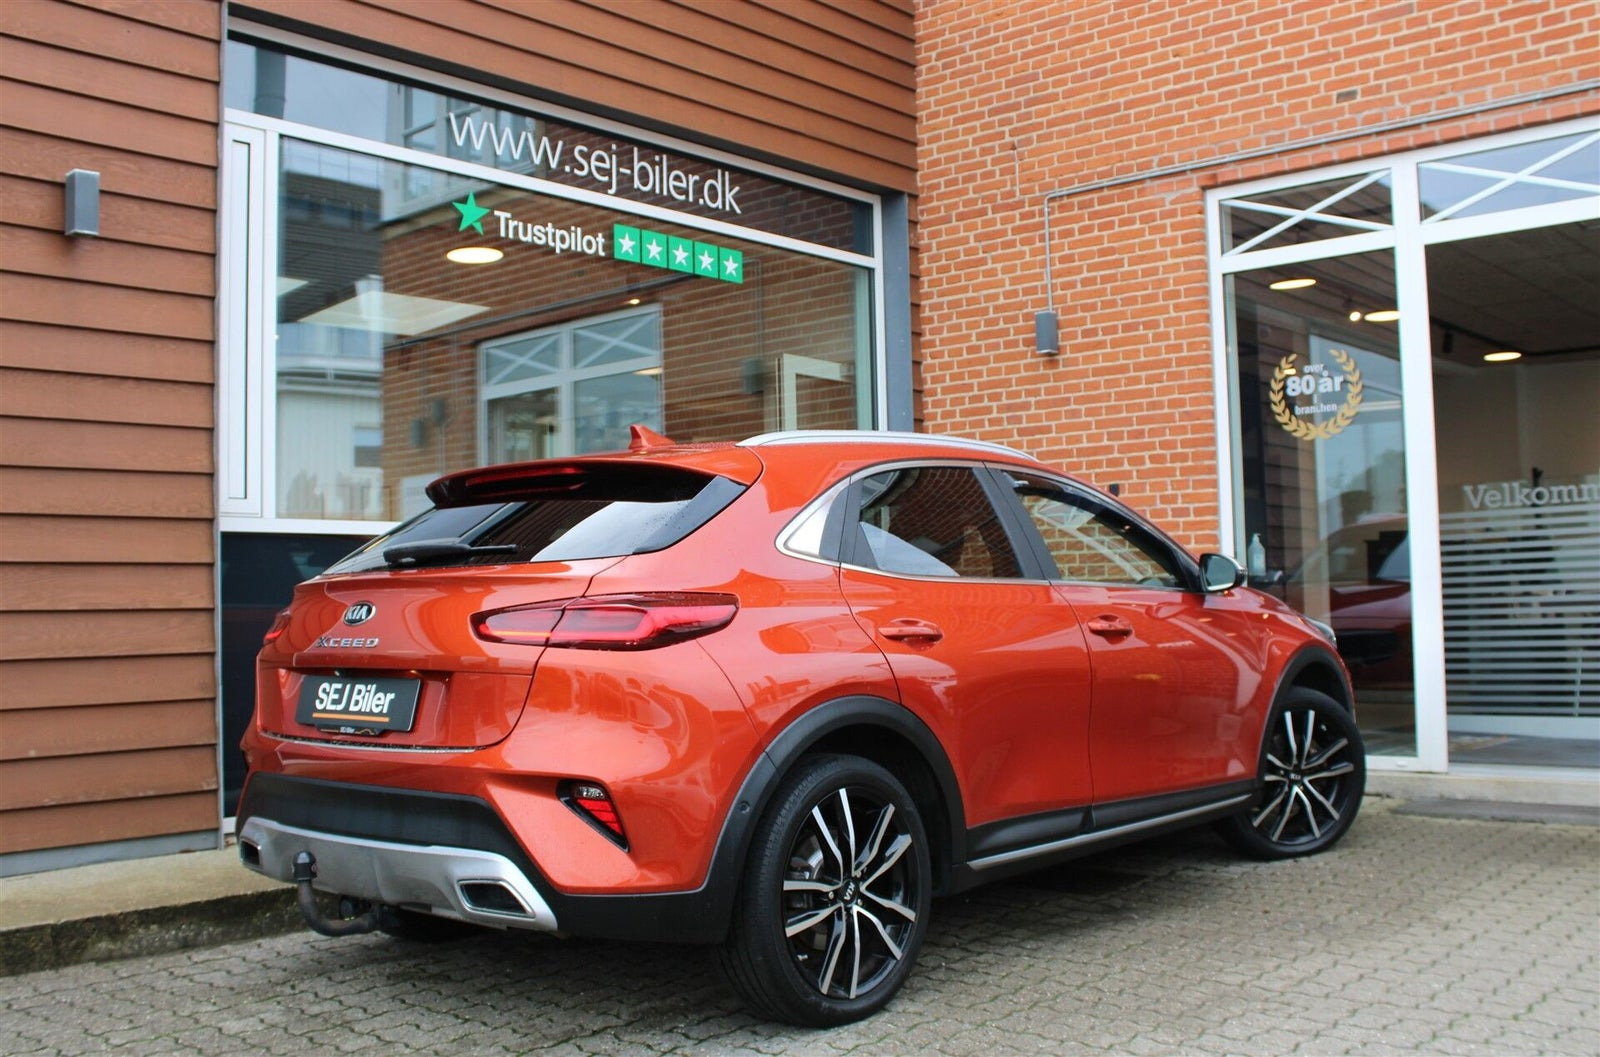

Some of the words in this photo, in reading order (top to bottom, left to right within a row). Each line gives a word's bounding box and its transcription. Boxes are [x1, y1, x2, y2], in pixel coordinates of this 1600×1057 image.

[449, 112, 742, 214] www.sej-biler.dk
[493, 210, 606, 257] Trustpilot
[1303, 364, 1324, 373] over
[1286, 375, 1316, 396] 80
[1318, 370, 1344, 393] år
[345, 605, 368, 620] KIA
[316, 637, 380, 648] XCEED
[315, 683, 351, 710] SEJ
[349, 684, 395, 713] Biler
